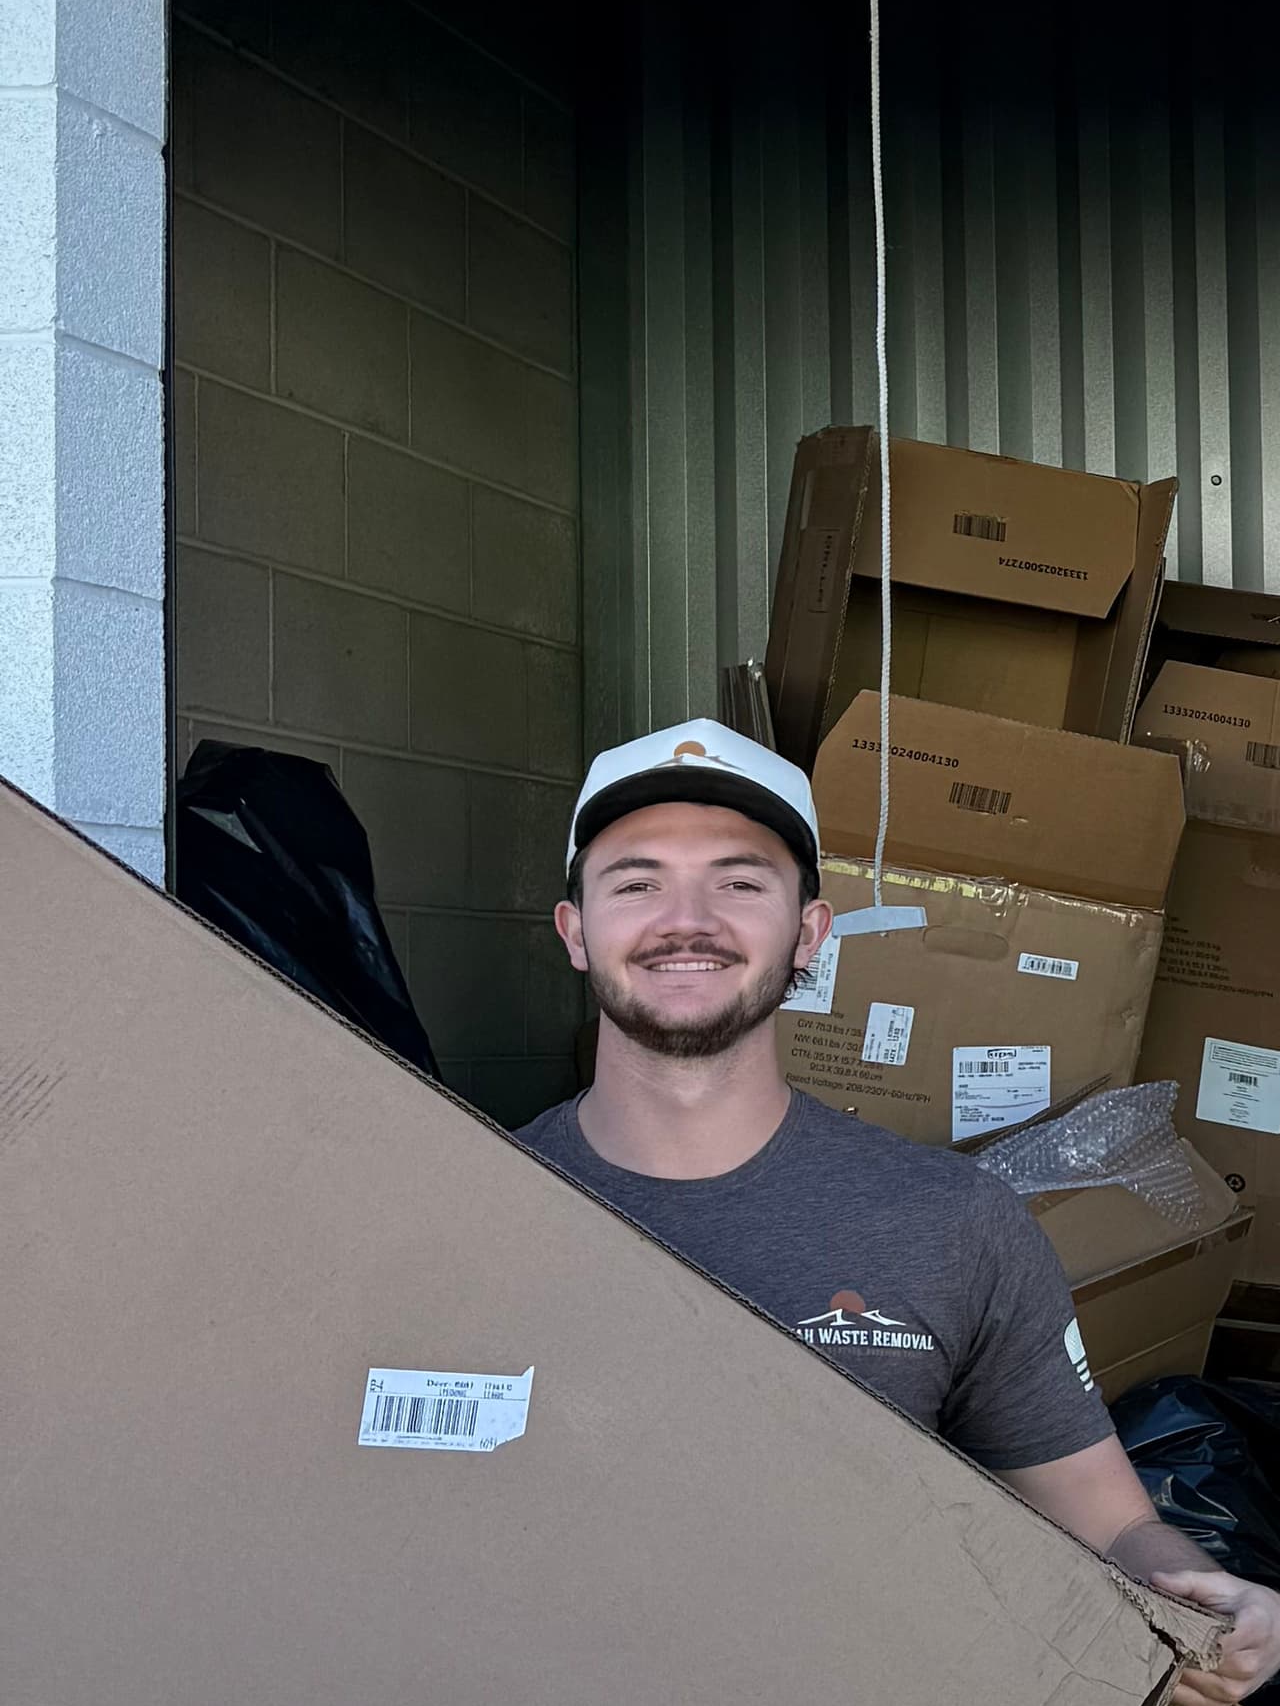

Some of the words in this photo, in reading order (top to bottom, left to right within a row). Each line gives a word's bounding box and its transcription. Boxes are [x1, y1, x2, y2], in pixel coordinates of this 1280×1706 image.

[1161, 704, 1252, 728] 13332024004130
[851, 738, 960, 769] 1333024004130
[792, 1329, 814, 1344] AH
[818, 1328, 869, 1346] WASTE
[872, 1330, 935, 1351] REMOVAL
